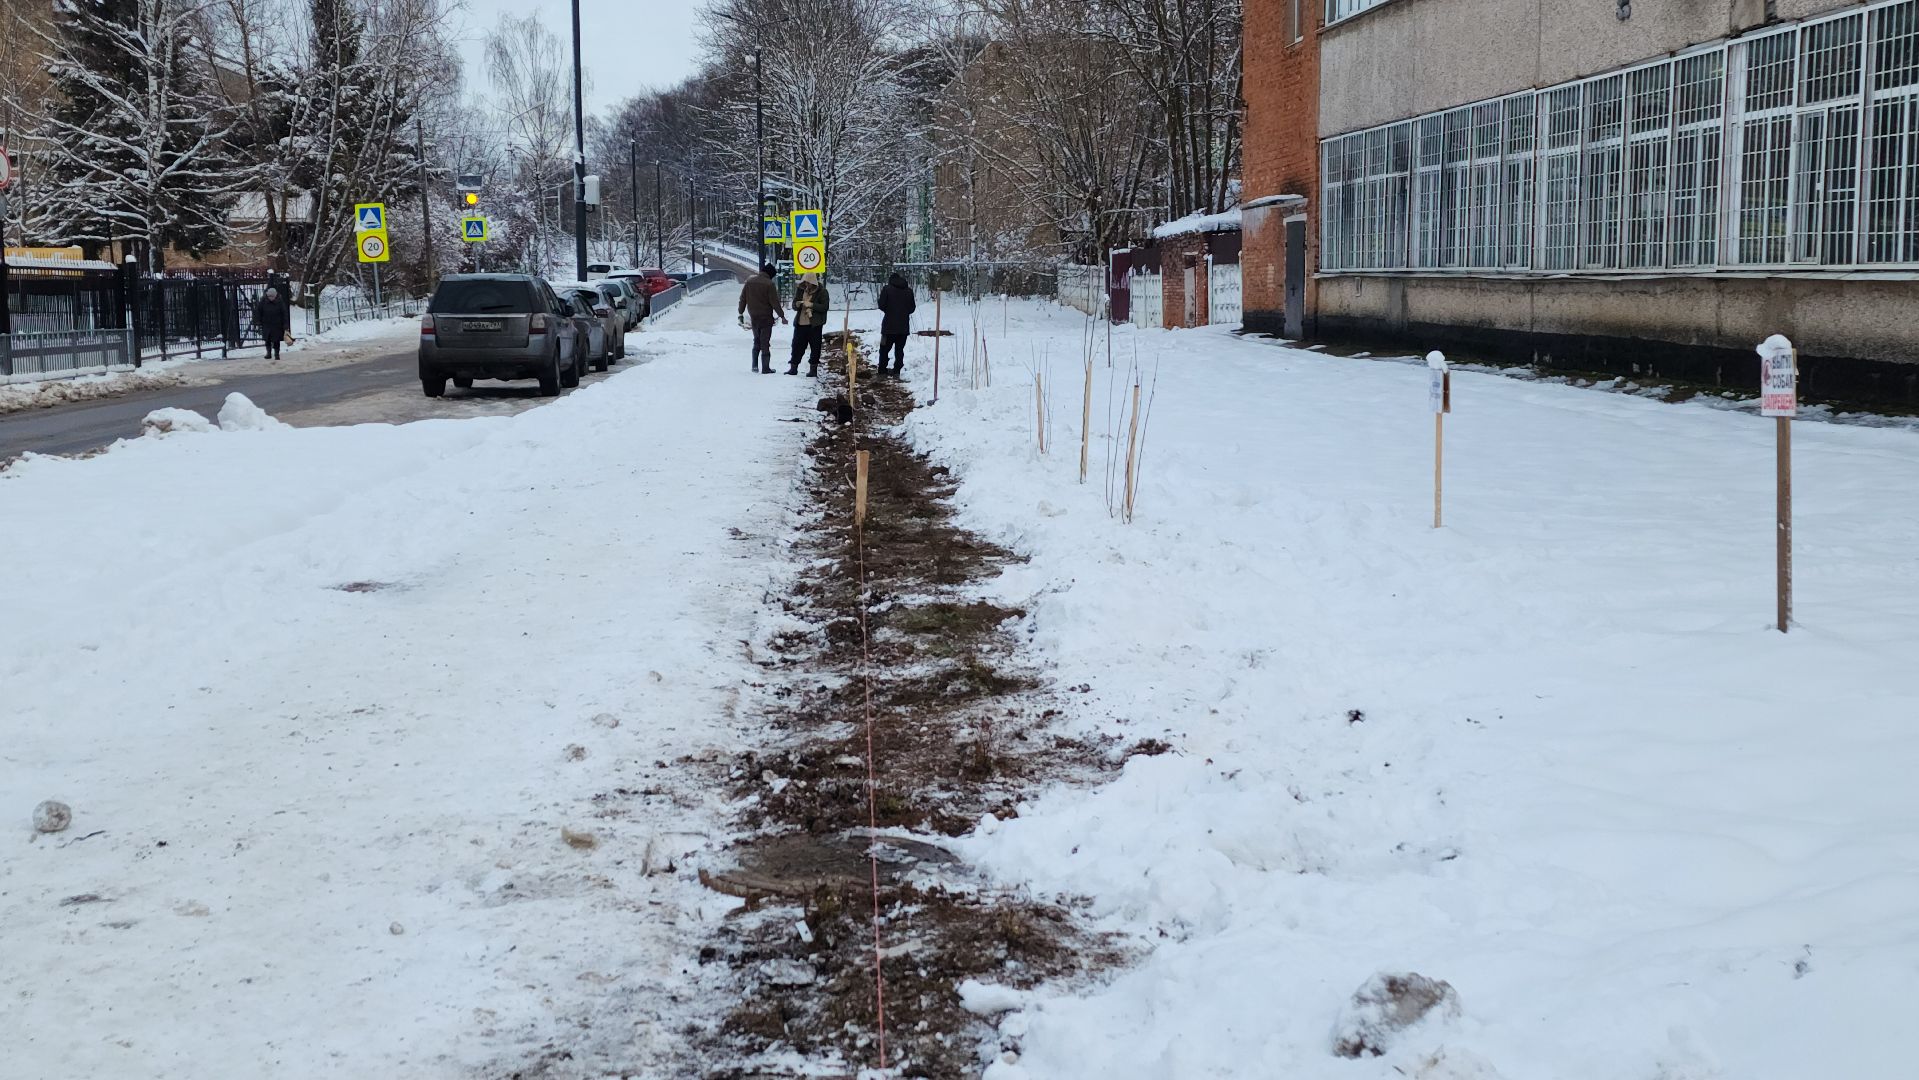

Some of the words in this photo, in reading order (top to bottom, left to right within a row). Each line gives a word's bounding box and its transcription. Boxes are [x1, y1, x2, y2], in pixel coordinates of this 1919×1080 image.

[367, 242, 380, 251] 20
[803, 252, 816, 262] 20
[1772, 354, 1793, 369] ВЫГУЛ
[1772, 374, 1793, 389] СОБАК
